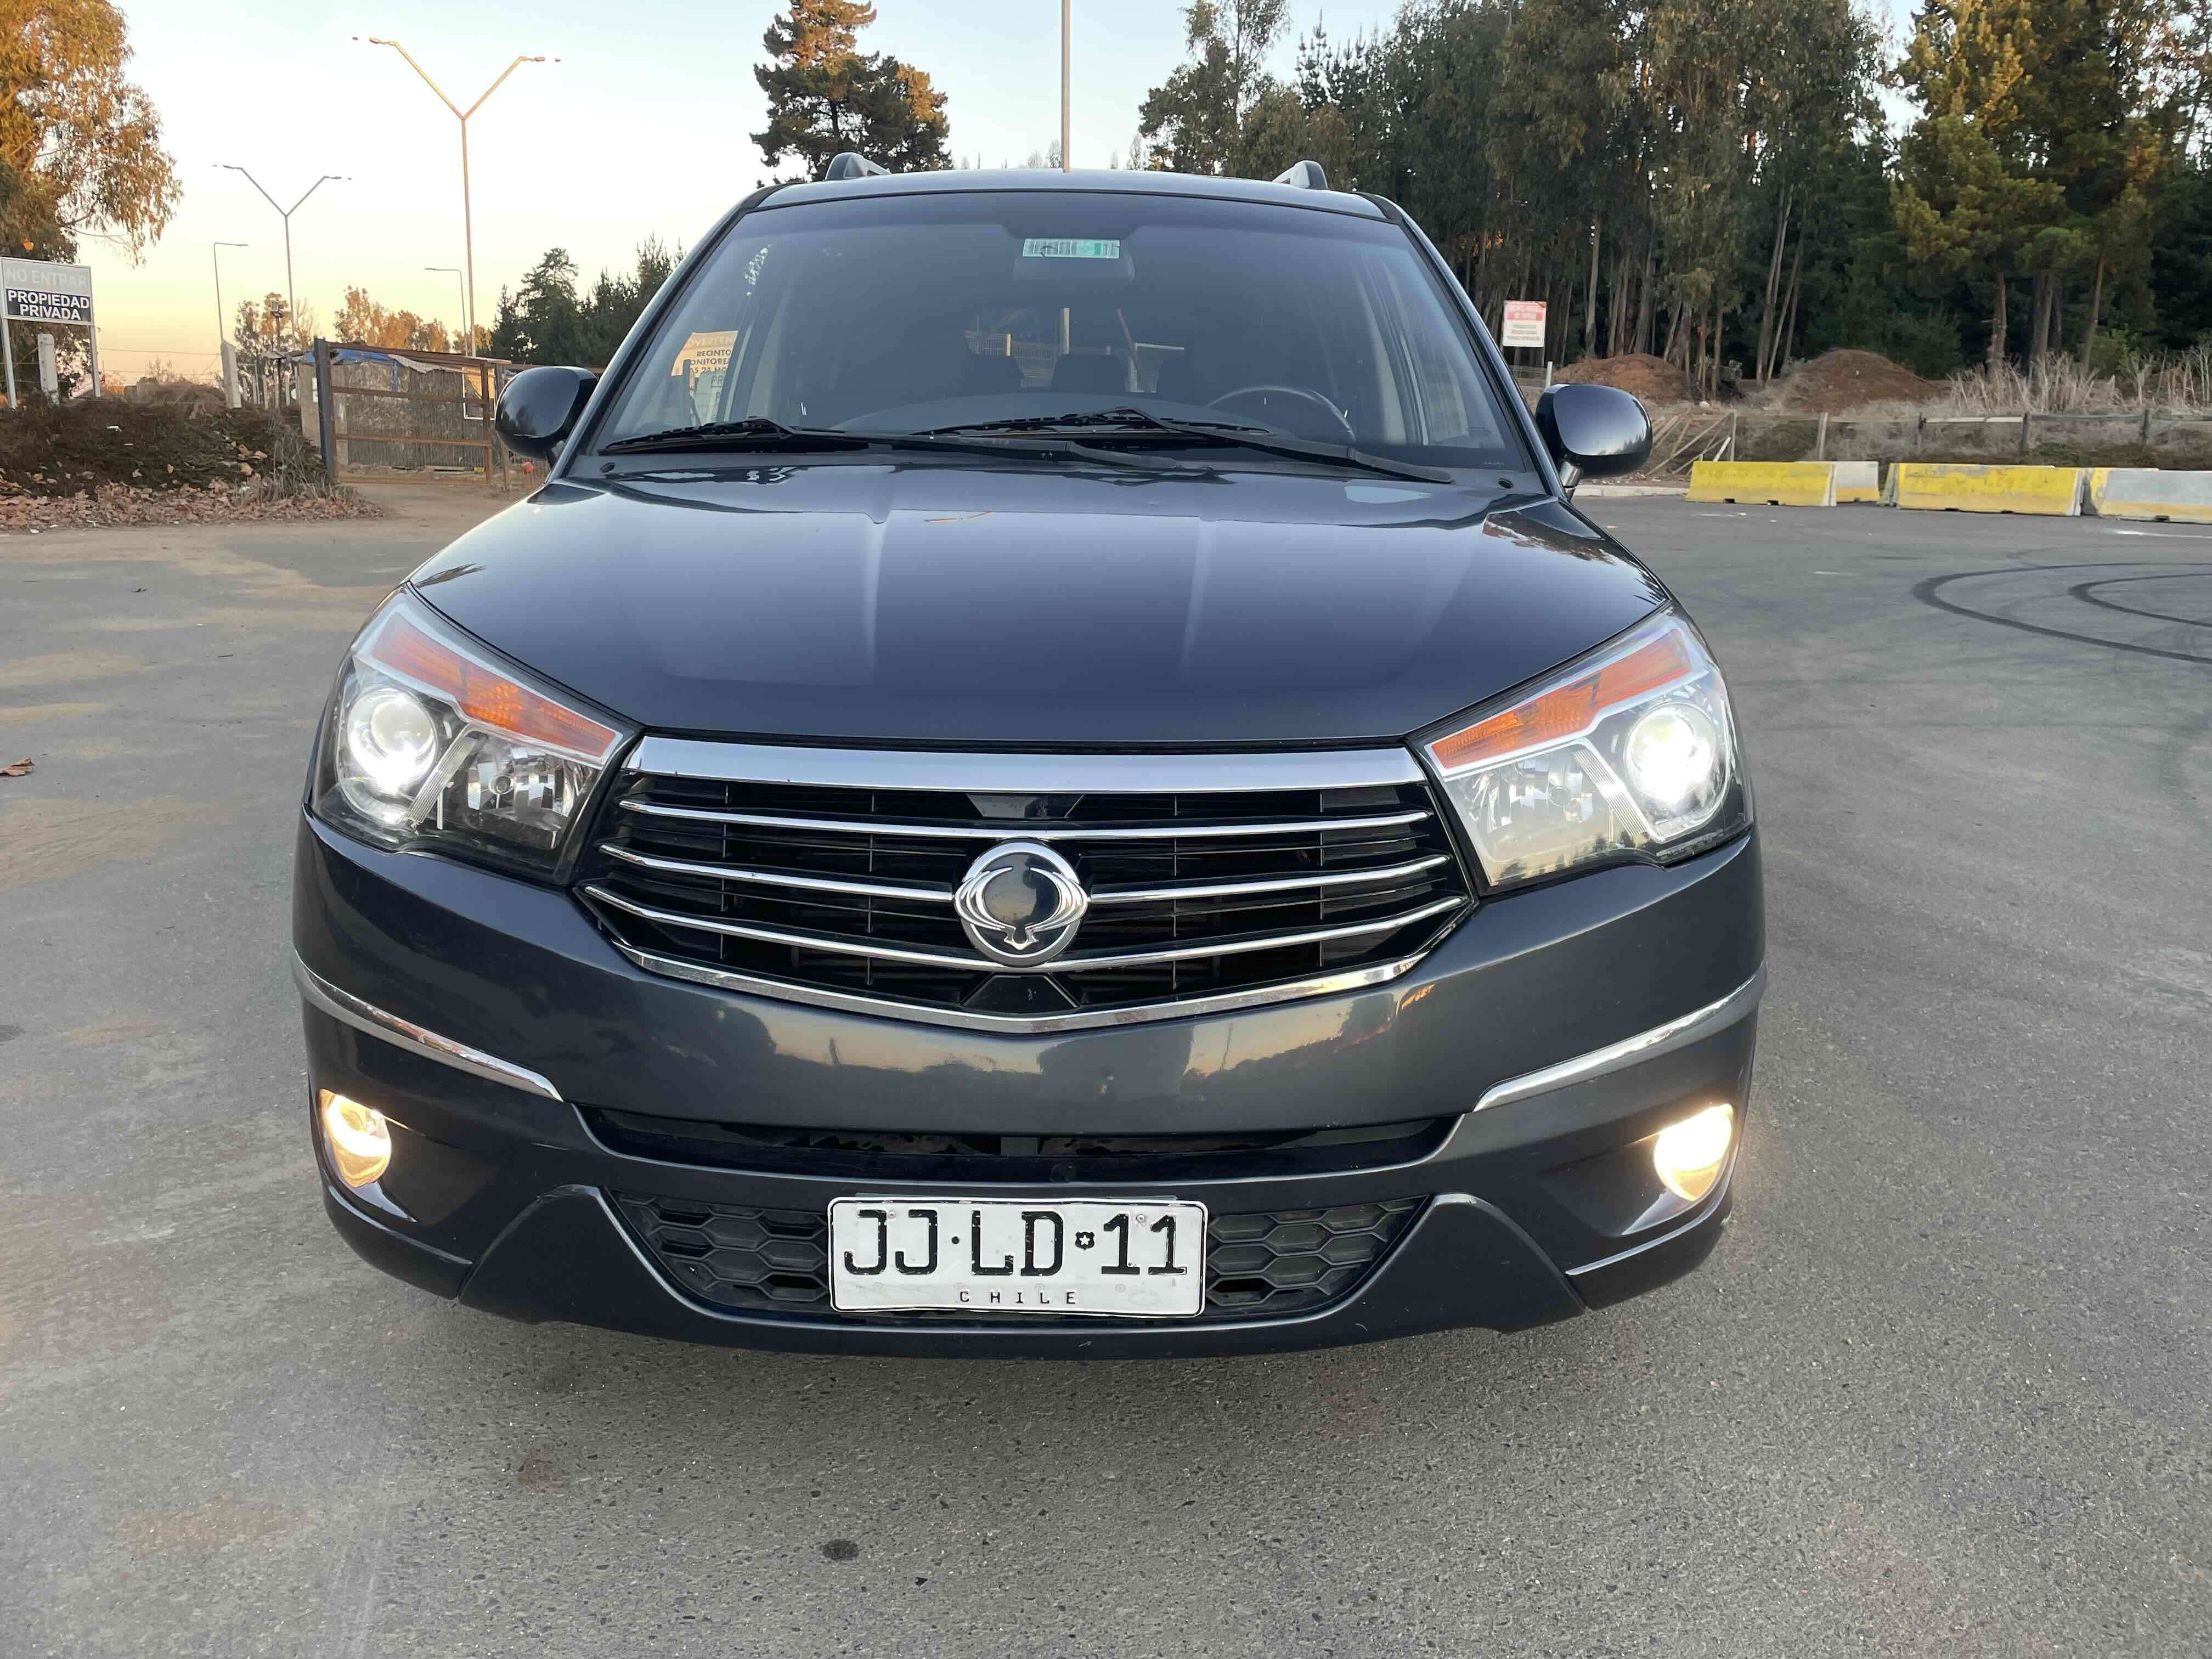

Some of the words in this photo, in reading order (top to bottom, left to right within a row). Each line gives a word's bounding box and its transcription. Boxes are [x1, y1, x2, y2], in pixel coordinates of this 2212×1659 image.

[31, 269, 87, 287] ENTRAR
[8, 290, 89, 308] PROPIEDAD
[20, 304, 81, 320] PRIVADA
[960, 1290, 1076, 1305] CHILE
